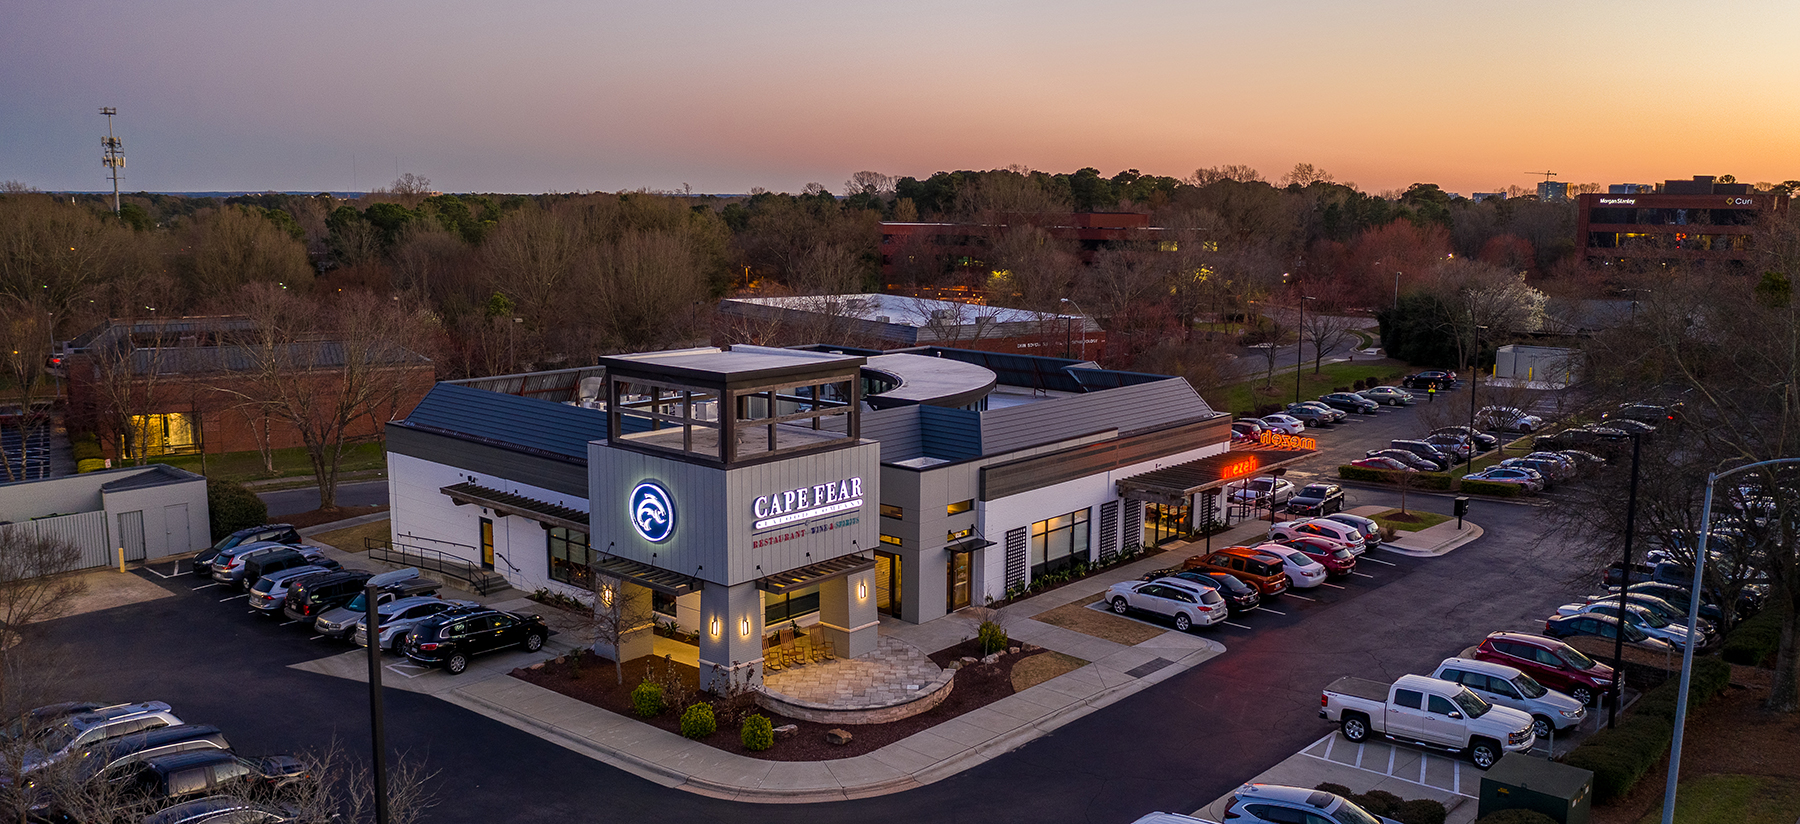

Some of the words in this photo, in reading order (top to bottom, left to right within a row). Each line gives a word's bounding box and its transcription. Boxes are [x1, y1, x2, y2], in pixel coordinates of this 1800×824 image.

[1222, 455, 1257, 479] mezeh
[754, 487, 809, 518] CAPE
[814, 477, 864, 506] FEAR
[753, 529, 806, 549] RESTAURANT
[811, 523, 828, 534] WINE
[835, 517, 860, 529] SPIRITS
